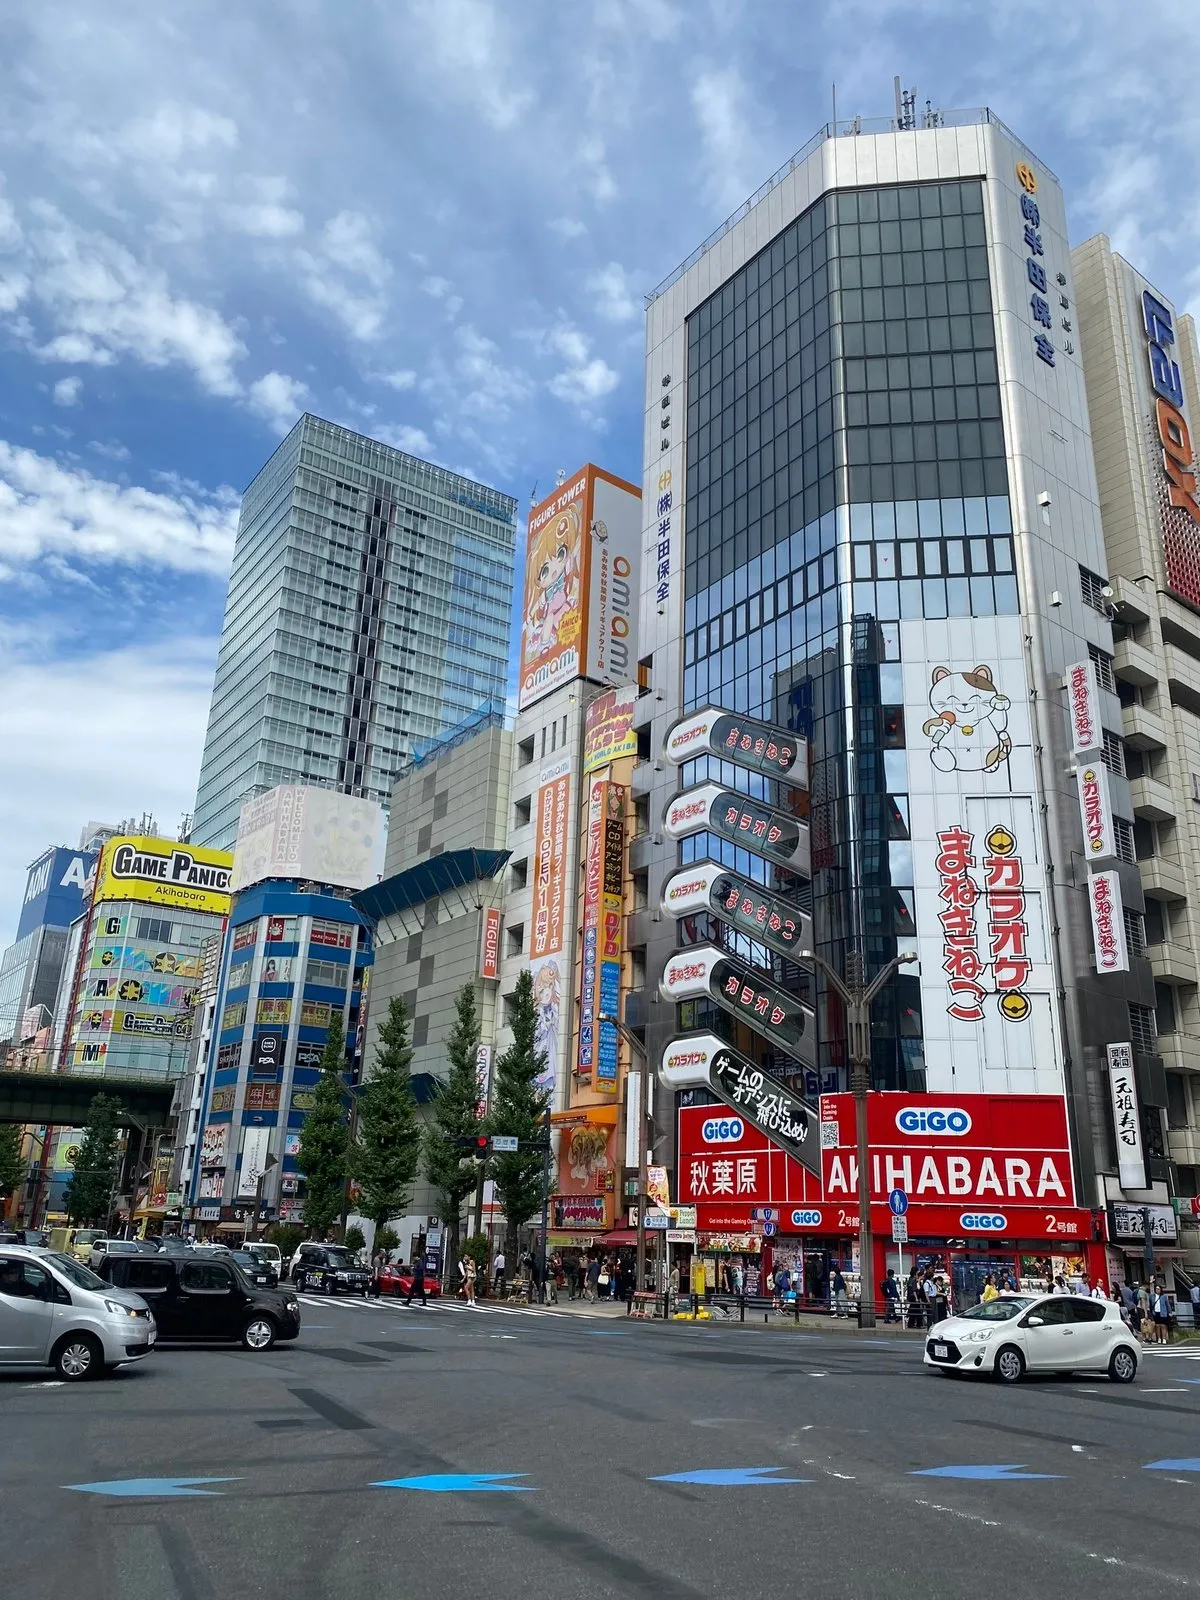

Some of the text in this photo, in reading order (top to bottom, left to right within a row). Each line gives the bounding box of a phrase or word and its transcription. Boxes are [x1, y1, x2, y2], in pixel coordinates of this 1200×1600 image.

[529, 477, 586, 534] FIGURE TOWER
[657, 491, 673, 603] (株)半田保全
[611, 556, 632, 678] amiami
[525, 646, 575, 690] amiami
[1070, 665, 1093, 748] まねきねこ
[676, 729, 702, 749] カラオケ
[725, 727, 792, 768] まねきねこ
[277, 792, 292, 861] AKIHABARA
[289, 788, 307, 861] WELCOME TO
[607, 821, 623, 831] ゲーム
[670, 799, 707, 826] まねきねこ
[725, 806, 782, 843] カラオケ
[1083, 782, 1103, 841] カラオケ
[608, 831, 621, 841] CD
[115, 847, 168, 878] GAME
[172, 853, 230, 888] PANIC
[540, 839, 551, 888] OPEN
[605, 851, 622, 862] アニメ
[24, 858, 52, 904] AOKI
[155, 886, 206, 902] Akihabara
[674, 881, 702, 900] カラオケ
[725, 887, 797, 940] まねきねこ
[936, 825, 986, 1022] まねきねこ
[984, 855, 1032, 990] カラオケ
[1093, 877, 1116, 968] まねきねこ
[485, 917, 498, 968] FIGURE
[604, 912, 620, 957] DVD
[669, 962, 707, 986] まねきねこ
[263, 1001, 288, 1013] 麻雀
[726, 976, 785, 1025] カラオケ
[259, 1057, 275, 1065] PSA
[298, 1053, 321, 1064] PSA
[673, 1050, 701, 1068] カラオケ
[714, 1055, 764, 1091] ゲームの
[250, 1088, 275, 1099] 麻雀
[733, 1083, 791, 1118] オアシスに
[1115, 1077, 1137, 1146] 元祖寿司
[704, 1120, 742, 1140] GiGO
[756, 1106, 808, 1143] 飛び込め!
[899, 1111, 969, 1132] GiGO
[690, 1158, 757, 1196] 秋葉原
[793, 1211, 820, 1224] GiGO
[838, 1210, 860, 1227] 2号館
[962, 1215, 1005, 1229] GiGO
[1045, 1215, 1078, 1234] 2号館
